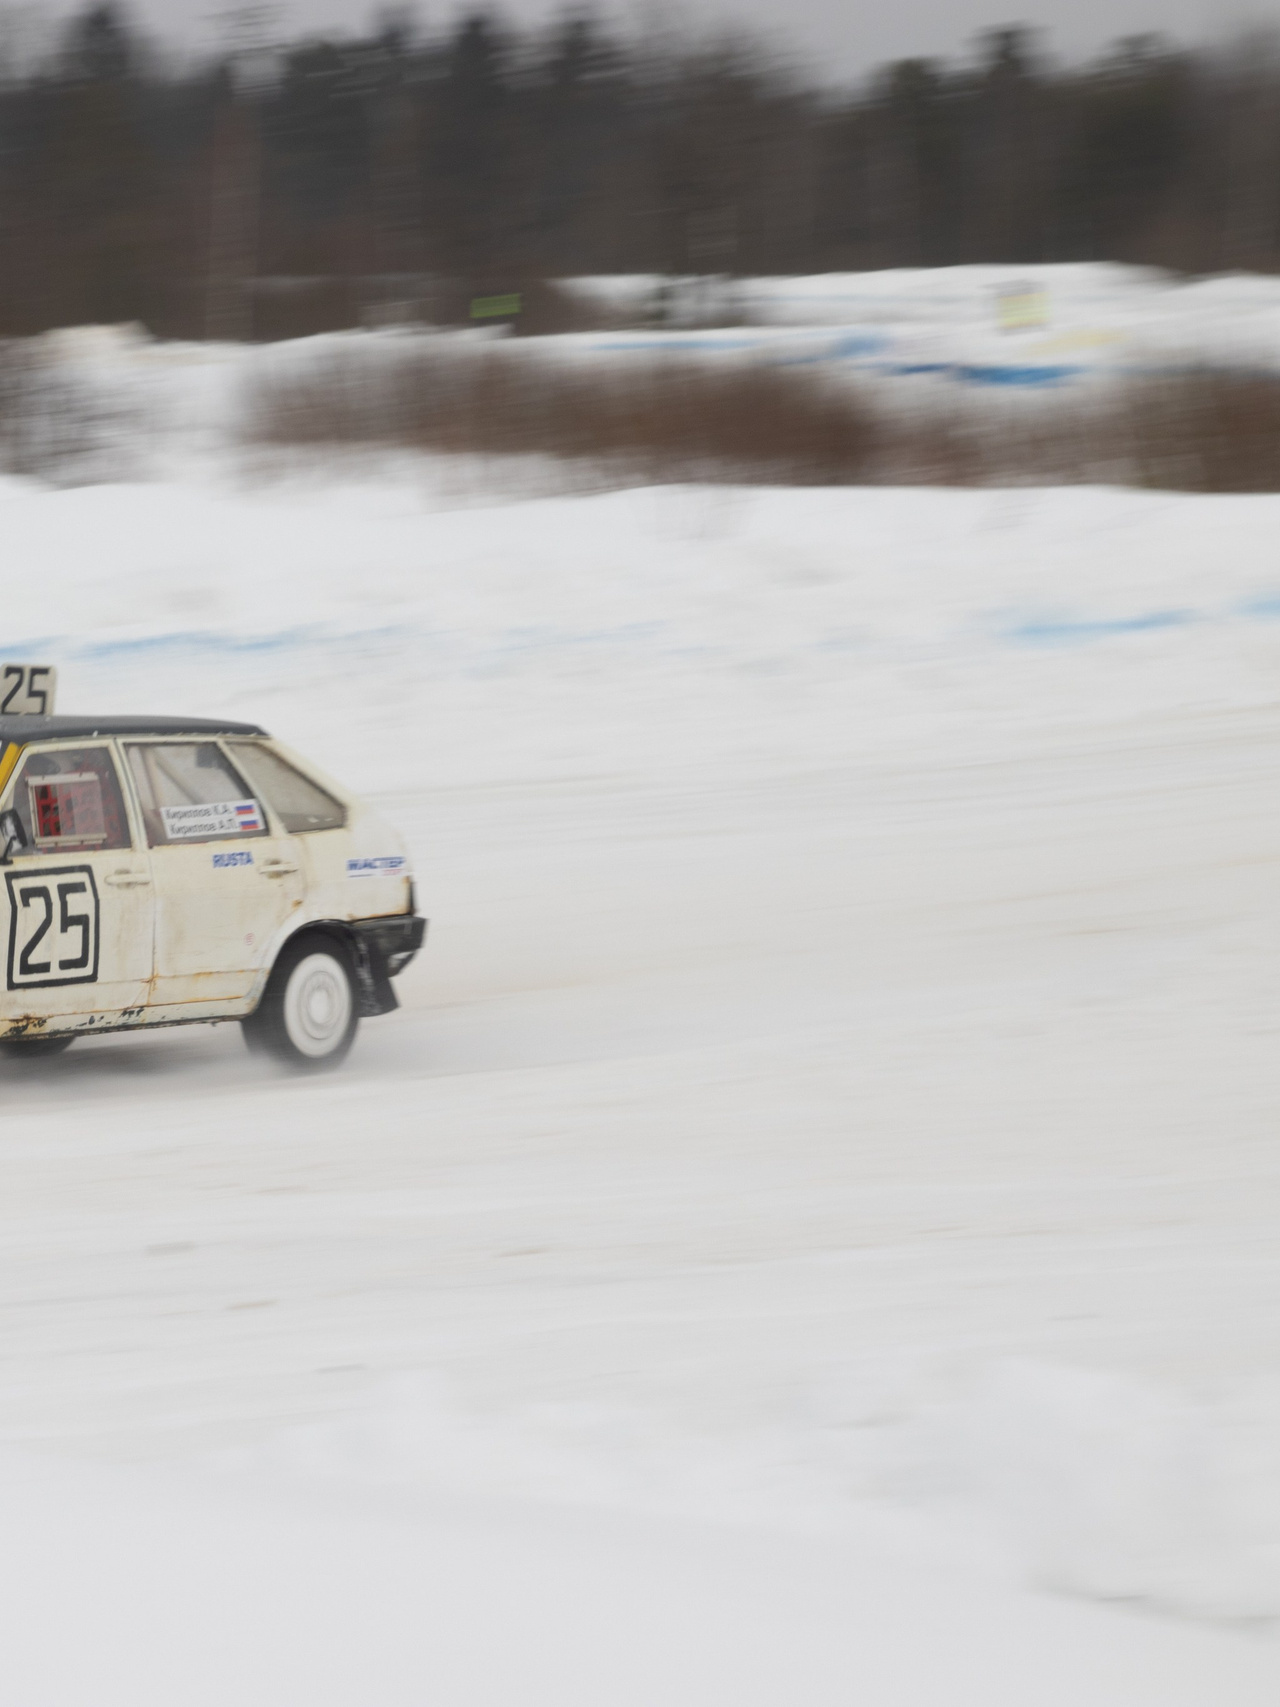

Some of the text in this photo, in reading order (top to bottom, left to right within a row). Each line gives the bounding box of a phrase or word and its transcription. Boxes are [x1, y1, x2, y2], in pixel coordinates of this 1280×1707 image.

[1, 666, 50, 715] 25
[212, 851, 254, 868] RUSTA
[19, 881, 90, 975] 25
